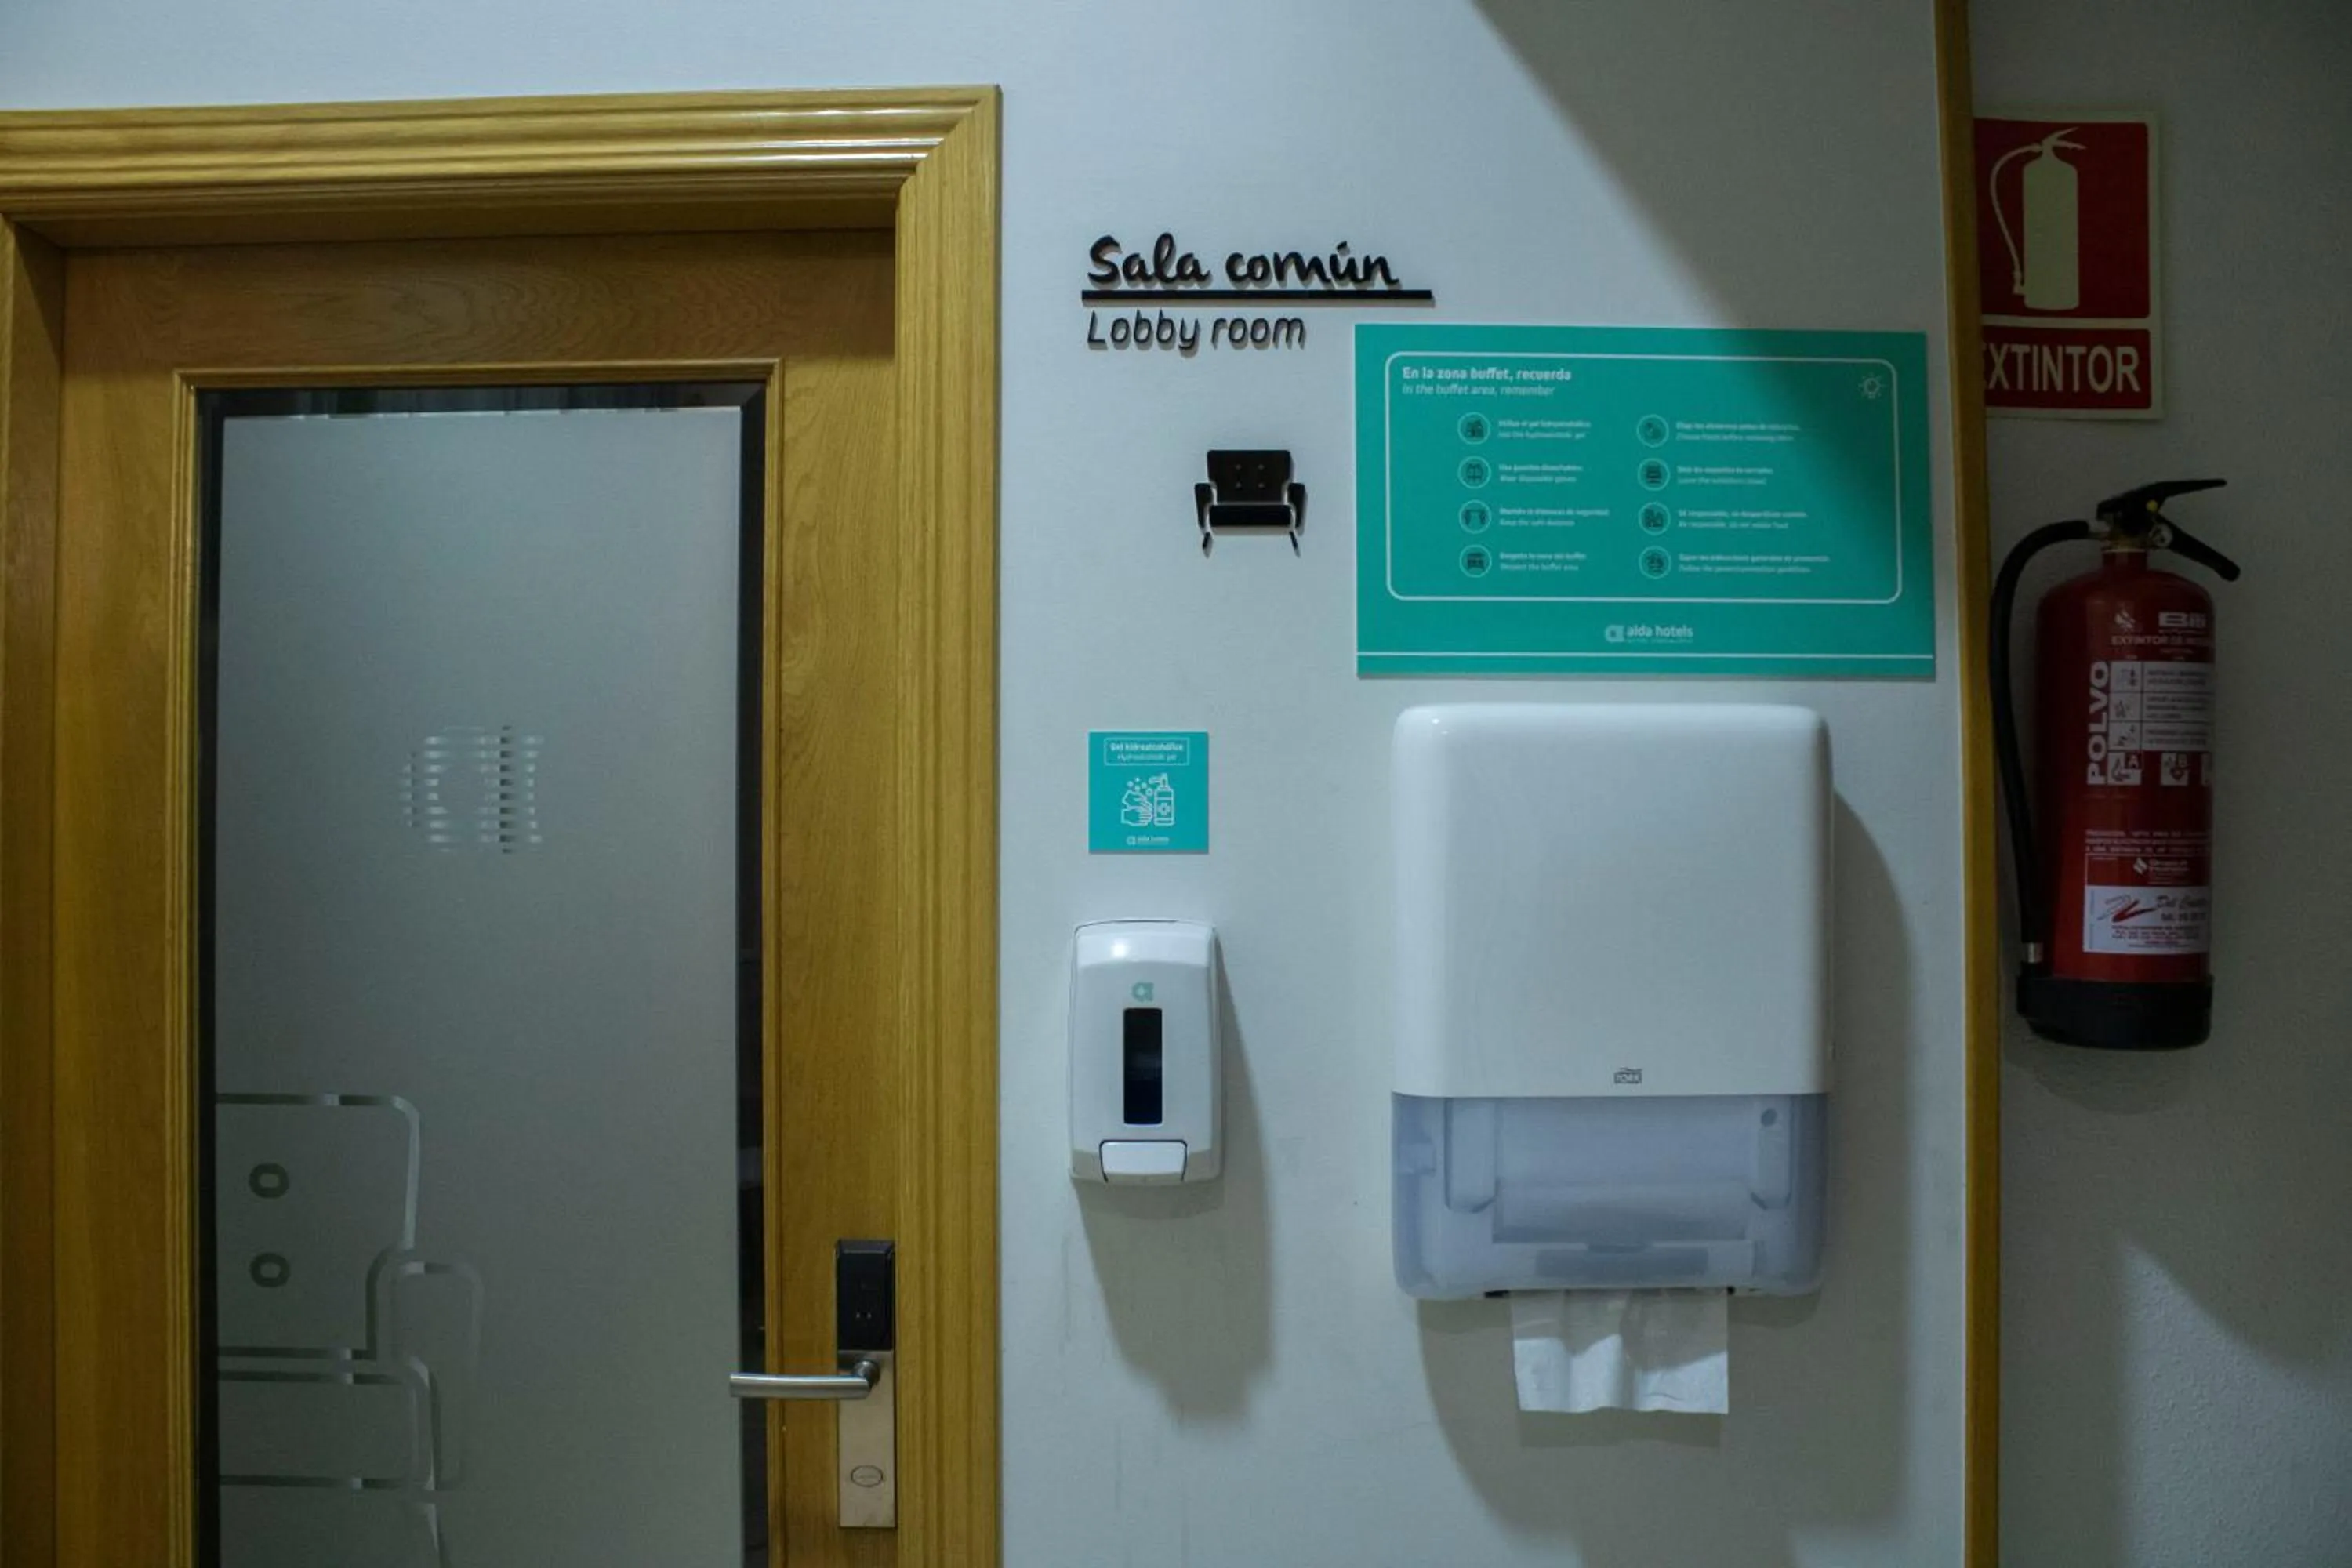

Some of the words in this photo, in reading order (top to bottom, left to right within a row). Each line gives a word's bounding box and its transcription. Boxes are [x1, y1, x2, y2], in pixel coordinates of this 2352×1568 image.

[1087, 232, 1209, 285] Sala
[1225, 241, 1400, 286] común
[1087, 309, 1199, 351] Lobby
[1210, 316, 1307, 347] room
[1402, 367, 1419, 379] En
[1422, 367, 1436, 379] la
[1437, 369, 1467, 380] zona
[1470, 367, 1513, 382] buffet,
[1517, 368, 1572, 381] recuerda
[1415, 384, 1434, 395] the
[1984, 343, 2141, 393] XTINTOR
[2086, 661, 2109, 785] POLVO
